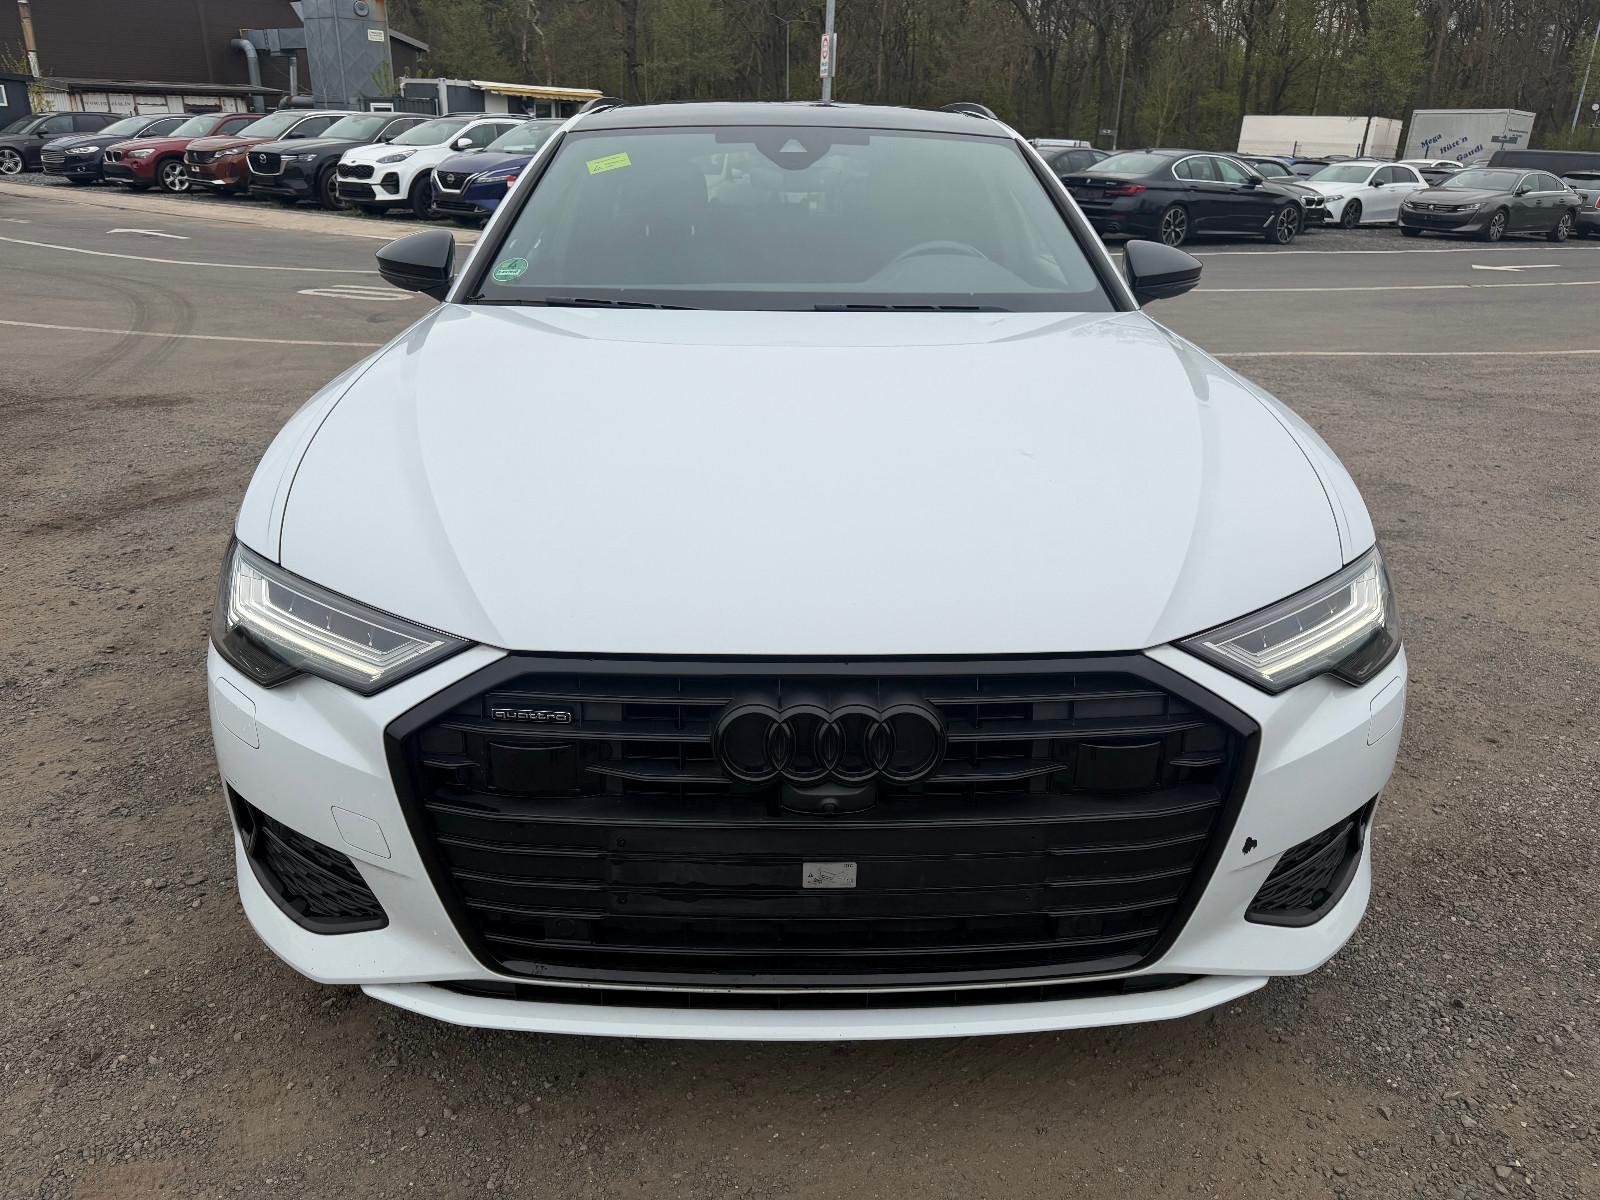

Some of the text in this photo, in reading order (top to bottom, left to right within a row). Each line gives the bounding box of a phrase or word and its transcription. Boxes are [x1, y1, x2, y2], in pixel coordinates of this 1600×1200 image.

[1421, 134, 1442, 149] Mega
[1456, 144, 1484, 162] Gaudi
[494, 711, 568, 721] quattro
